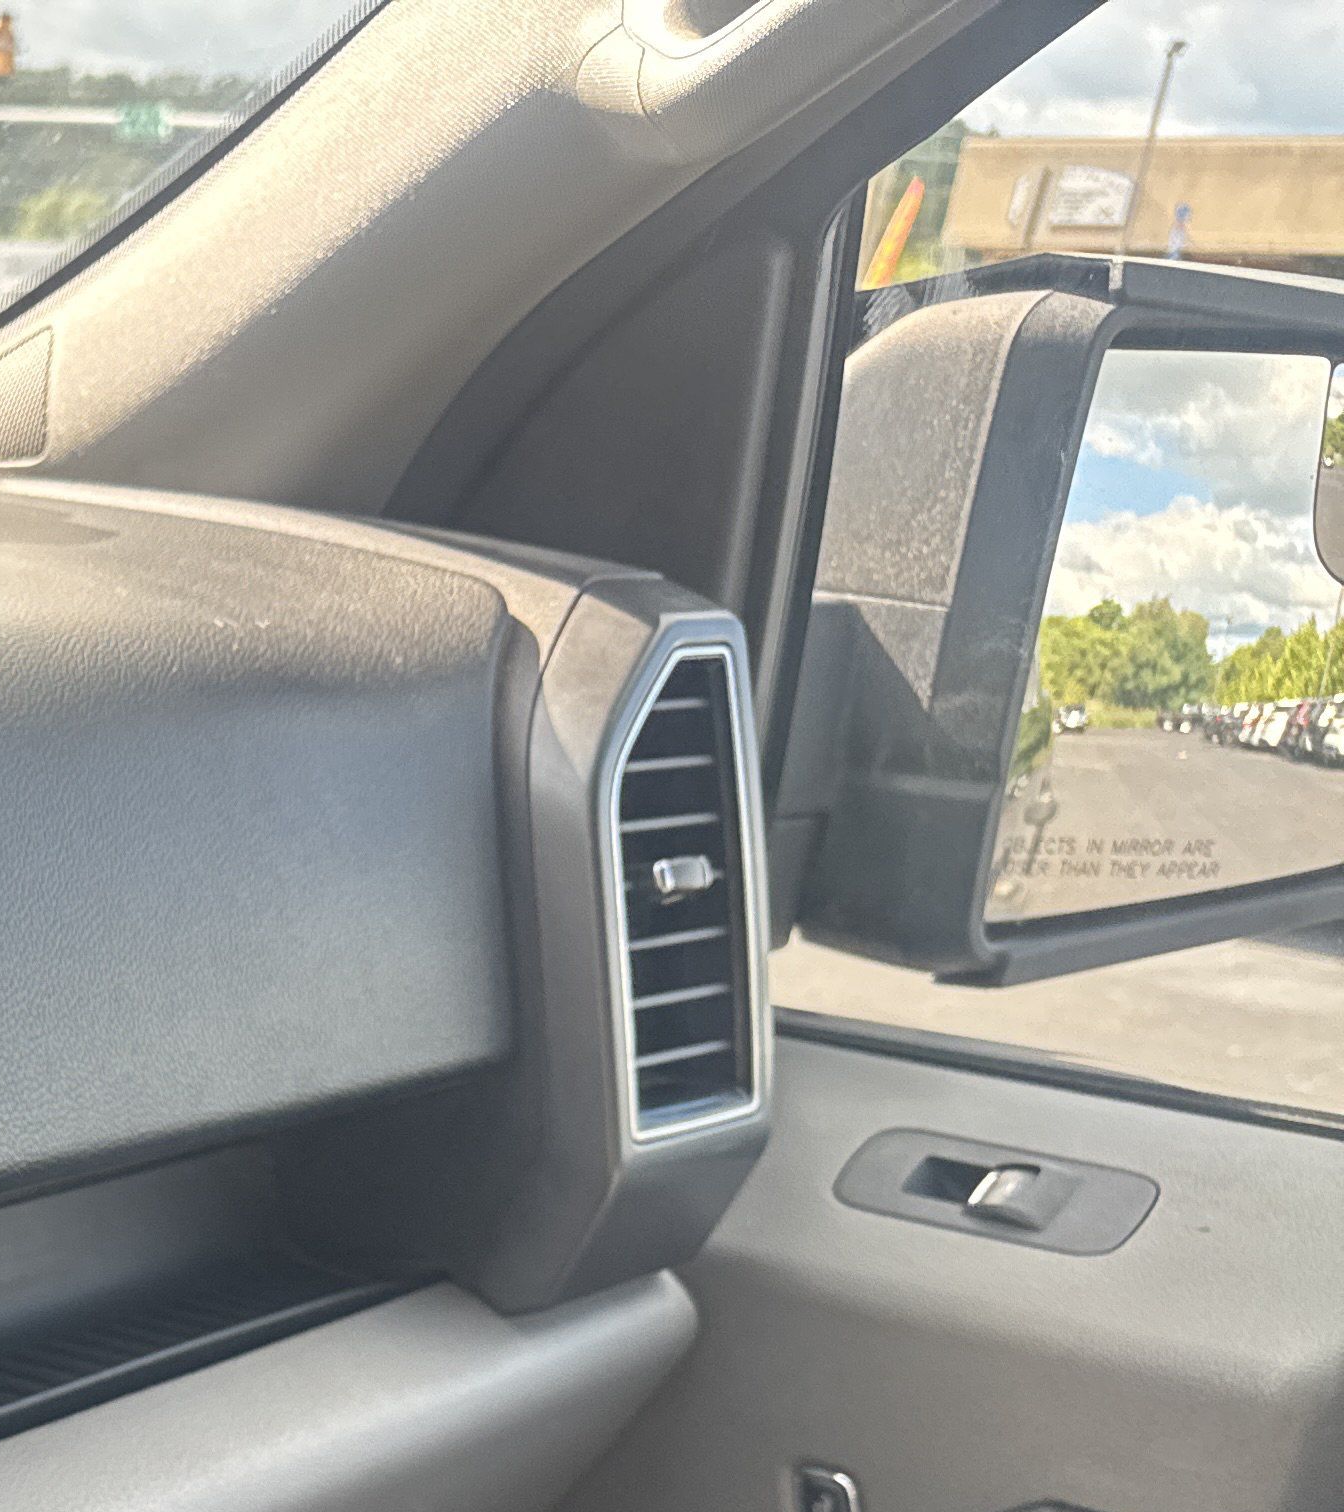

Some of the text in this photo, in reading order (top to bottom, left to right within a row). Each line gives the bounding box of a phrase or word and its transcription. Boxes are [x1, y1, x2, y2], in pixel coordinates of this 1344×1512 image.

[1086, 838, 1103, 855] IN
[1111, 838, 1175, 856] MIRROR
[1182, 838, 1215, 857] ARE
[1060, 858, 1101, 877] THAN
[1110, 859, 1151, 879] THEY
[1155, 860, 1219, 880] APPEAR
